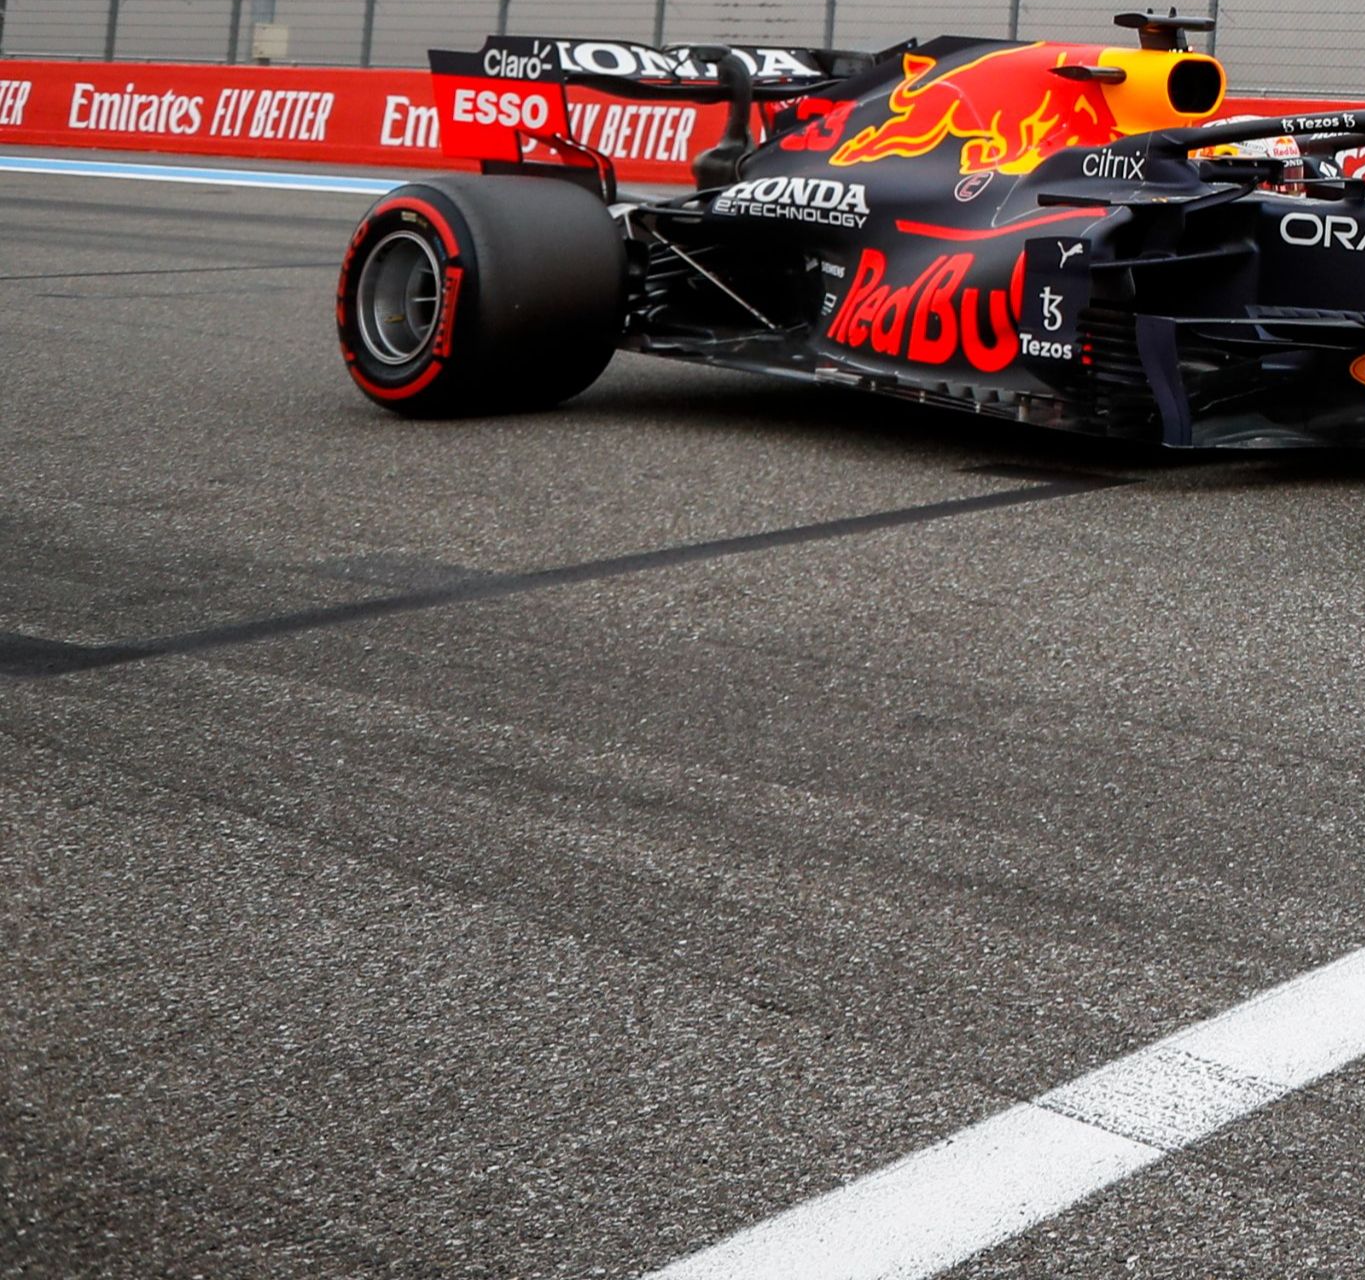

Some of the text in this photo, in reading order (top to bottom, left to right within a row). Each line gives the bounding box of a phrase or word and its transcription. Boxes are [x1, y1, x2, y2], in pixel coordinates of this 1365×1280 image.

[68, 82, 204, 135] Emirates
[209, 88, 255, 136] FLY
[249, 89, 335, 141] BETTER
[453, 89, 548, 128] ESSO
[1296, 116, 1340, 130] Tezos
[598, 104, 697, 162] BETTER
[1083, 148, 1145, 180] citrix
[721, 176, 871, 215] HONDA
[1019, 333, 1073, 360] Tezos
